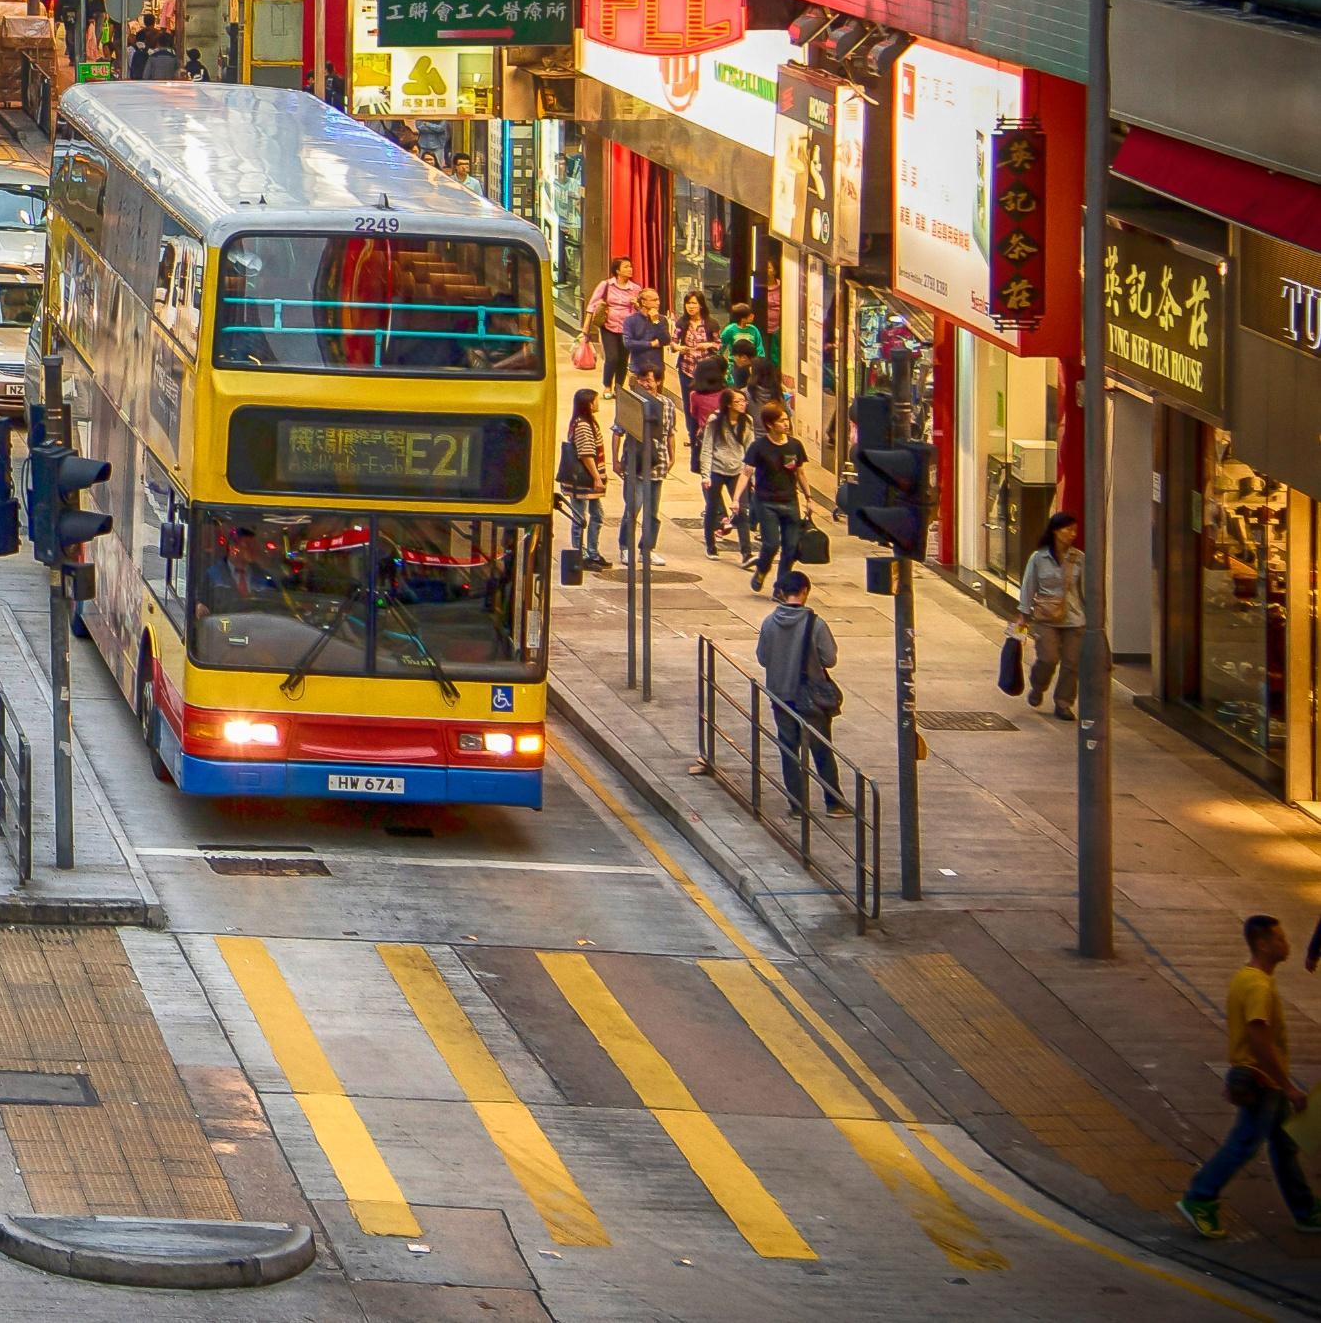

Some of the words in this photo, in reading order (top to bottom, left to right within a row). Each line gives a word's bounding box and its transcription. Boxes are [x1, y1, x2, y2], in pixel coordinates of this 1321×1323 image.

[354, 217, 400, 233] 2249
[1131, 333, 1150, 369] KEE
[1152, 342, 1171, 378] TEA
[1171, 350, 1203, 393] HOUSE
[406, 432, 469, 478] E21
[337, 776, 358, 790] HW
[363, 776, 396, 791] 674
